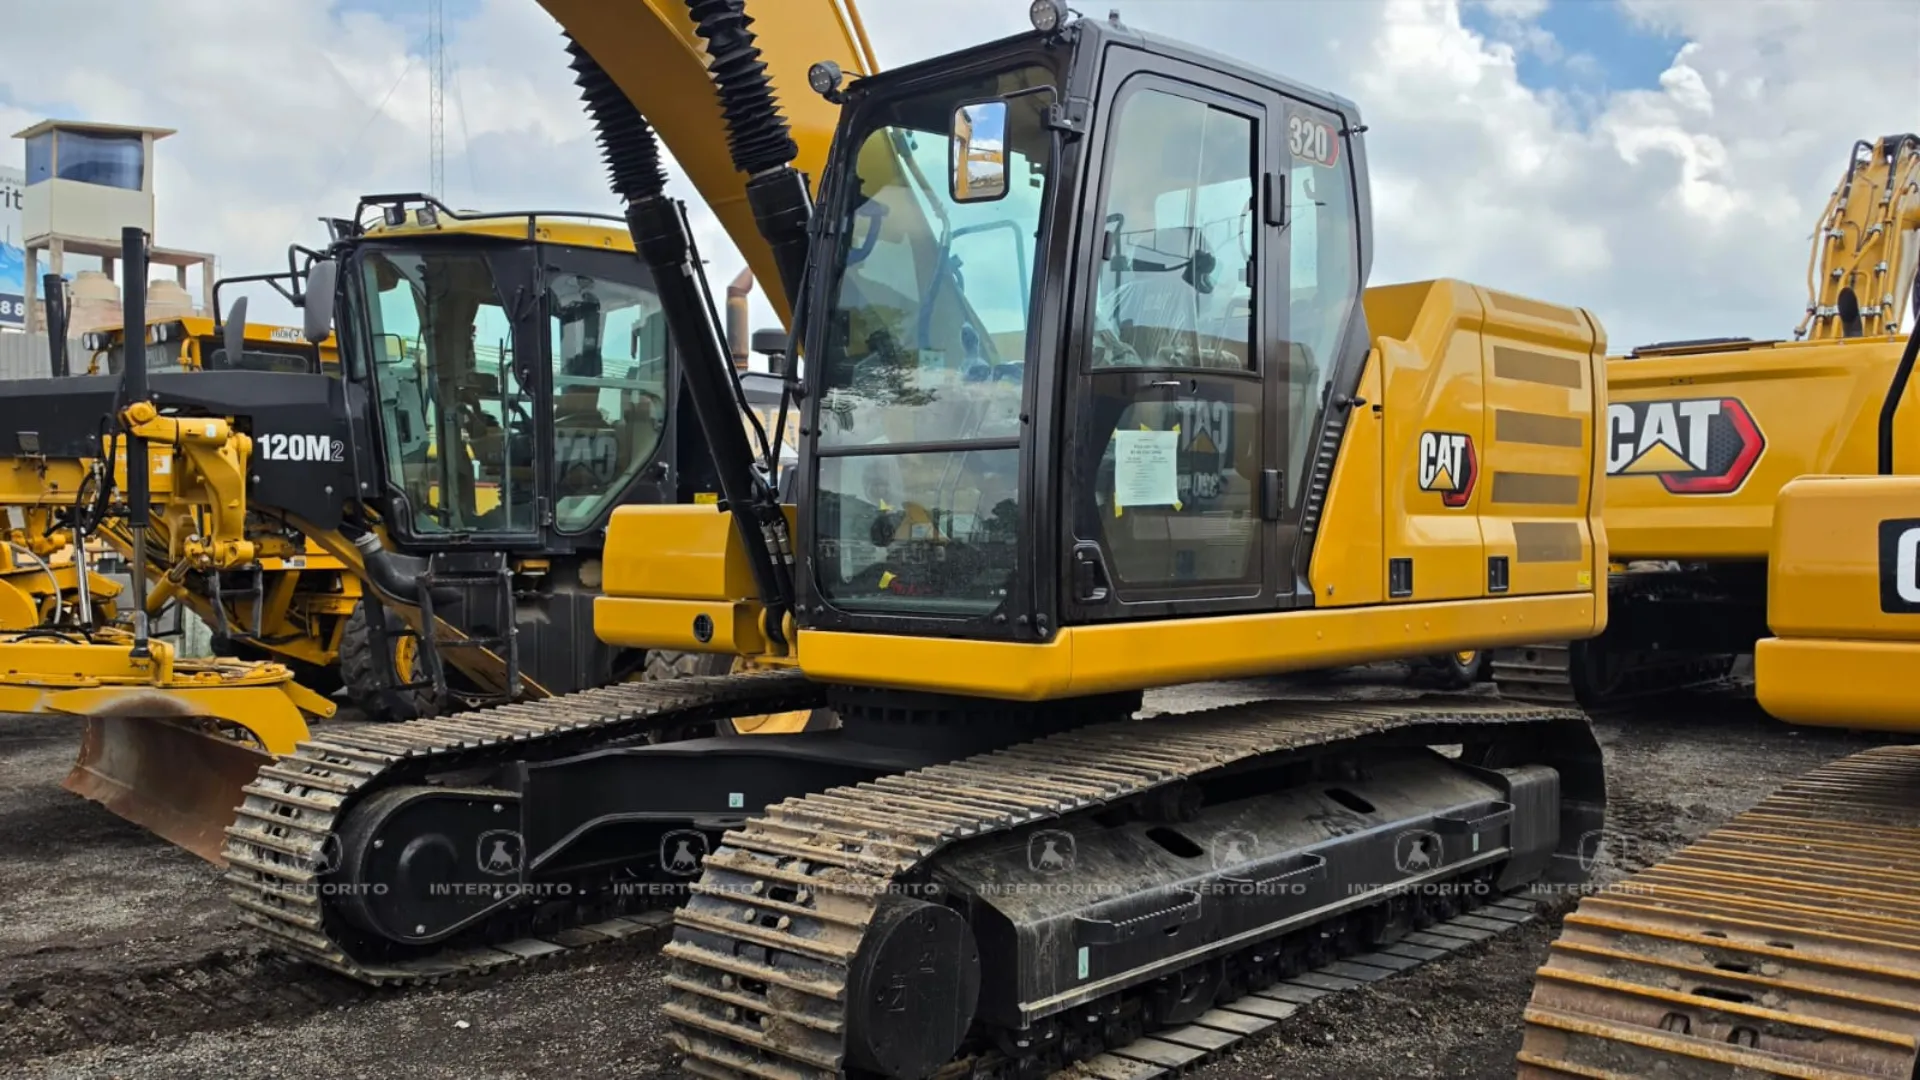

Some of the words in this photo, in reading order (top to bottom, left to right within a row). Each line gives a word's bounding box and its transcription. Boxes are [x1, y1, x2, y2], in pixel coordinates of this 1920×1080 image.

[1289, 115, 1328, 162] 320
[257, 433, 344, 462] 120M2
[1420, 432, 1466, 490] CAT
[1607, 399, 1721, 474] CAT
